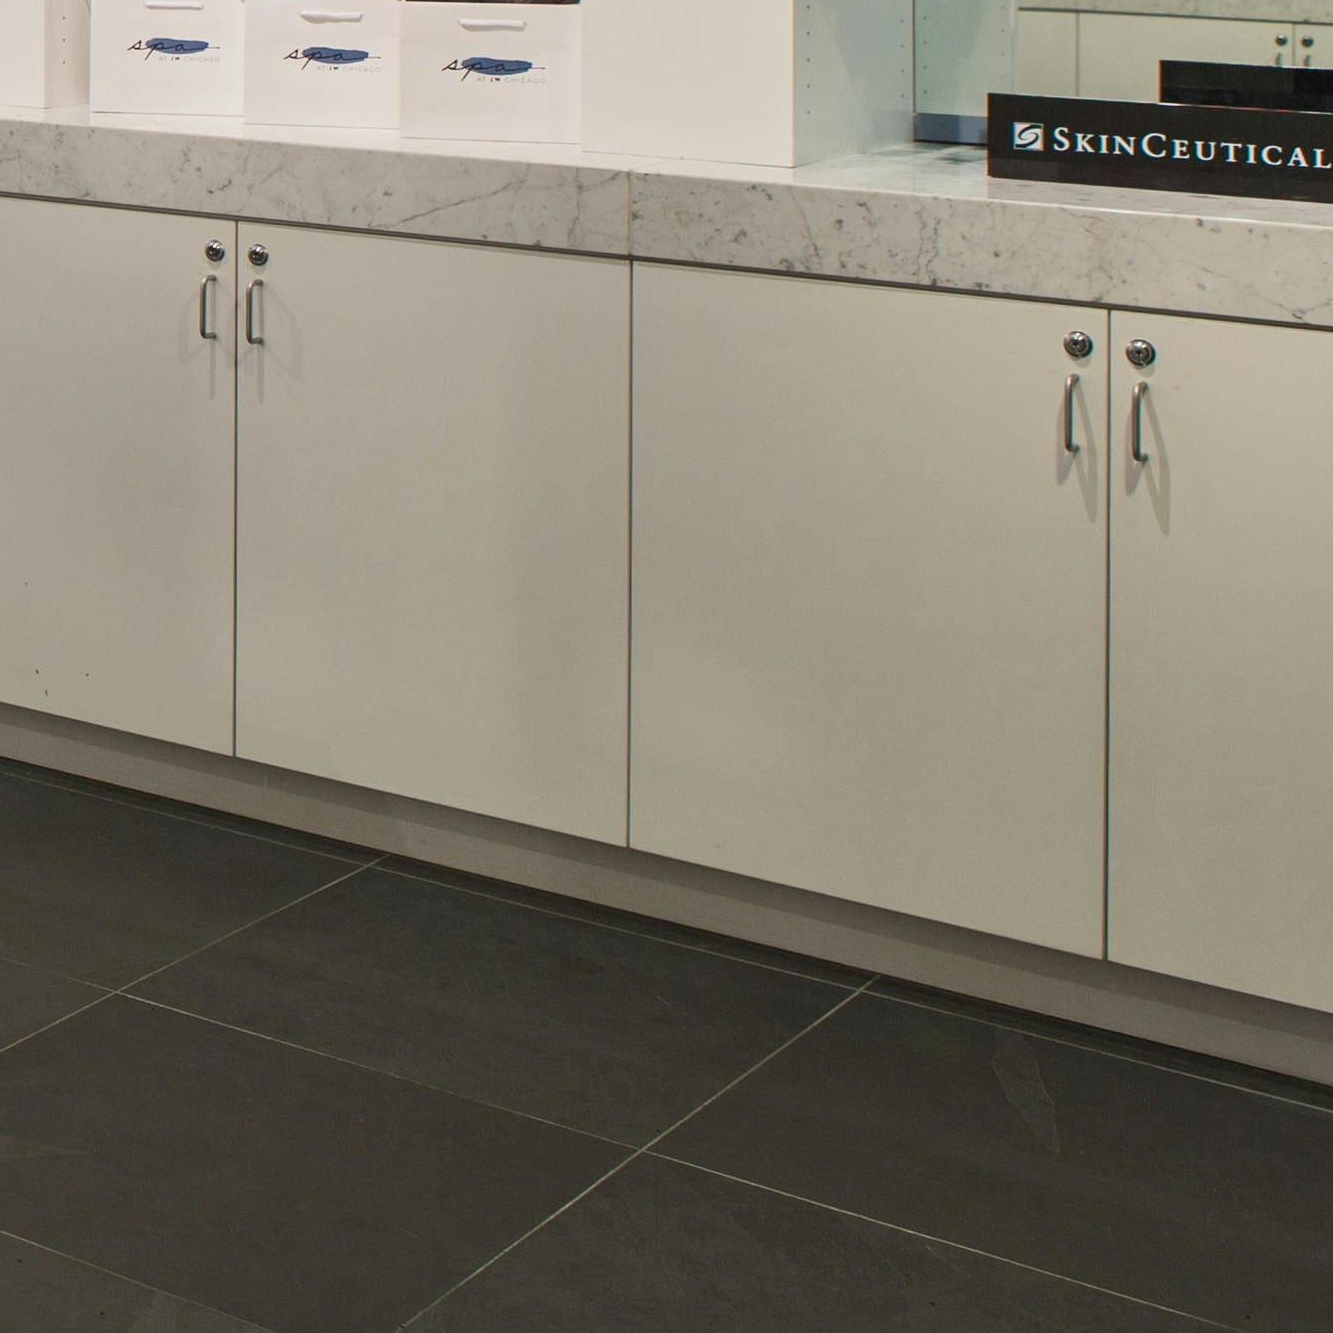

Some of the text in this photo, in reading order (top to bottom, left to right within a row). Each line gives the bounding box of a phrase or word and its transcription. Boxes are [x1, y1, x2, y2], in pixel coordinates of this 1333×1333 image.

[127, 40, 220, 60] spa
[283, 49, 381, 70] spa
[441, 59, 546, 81] spa
